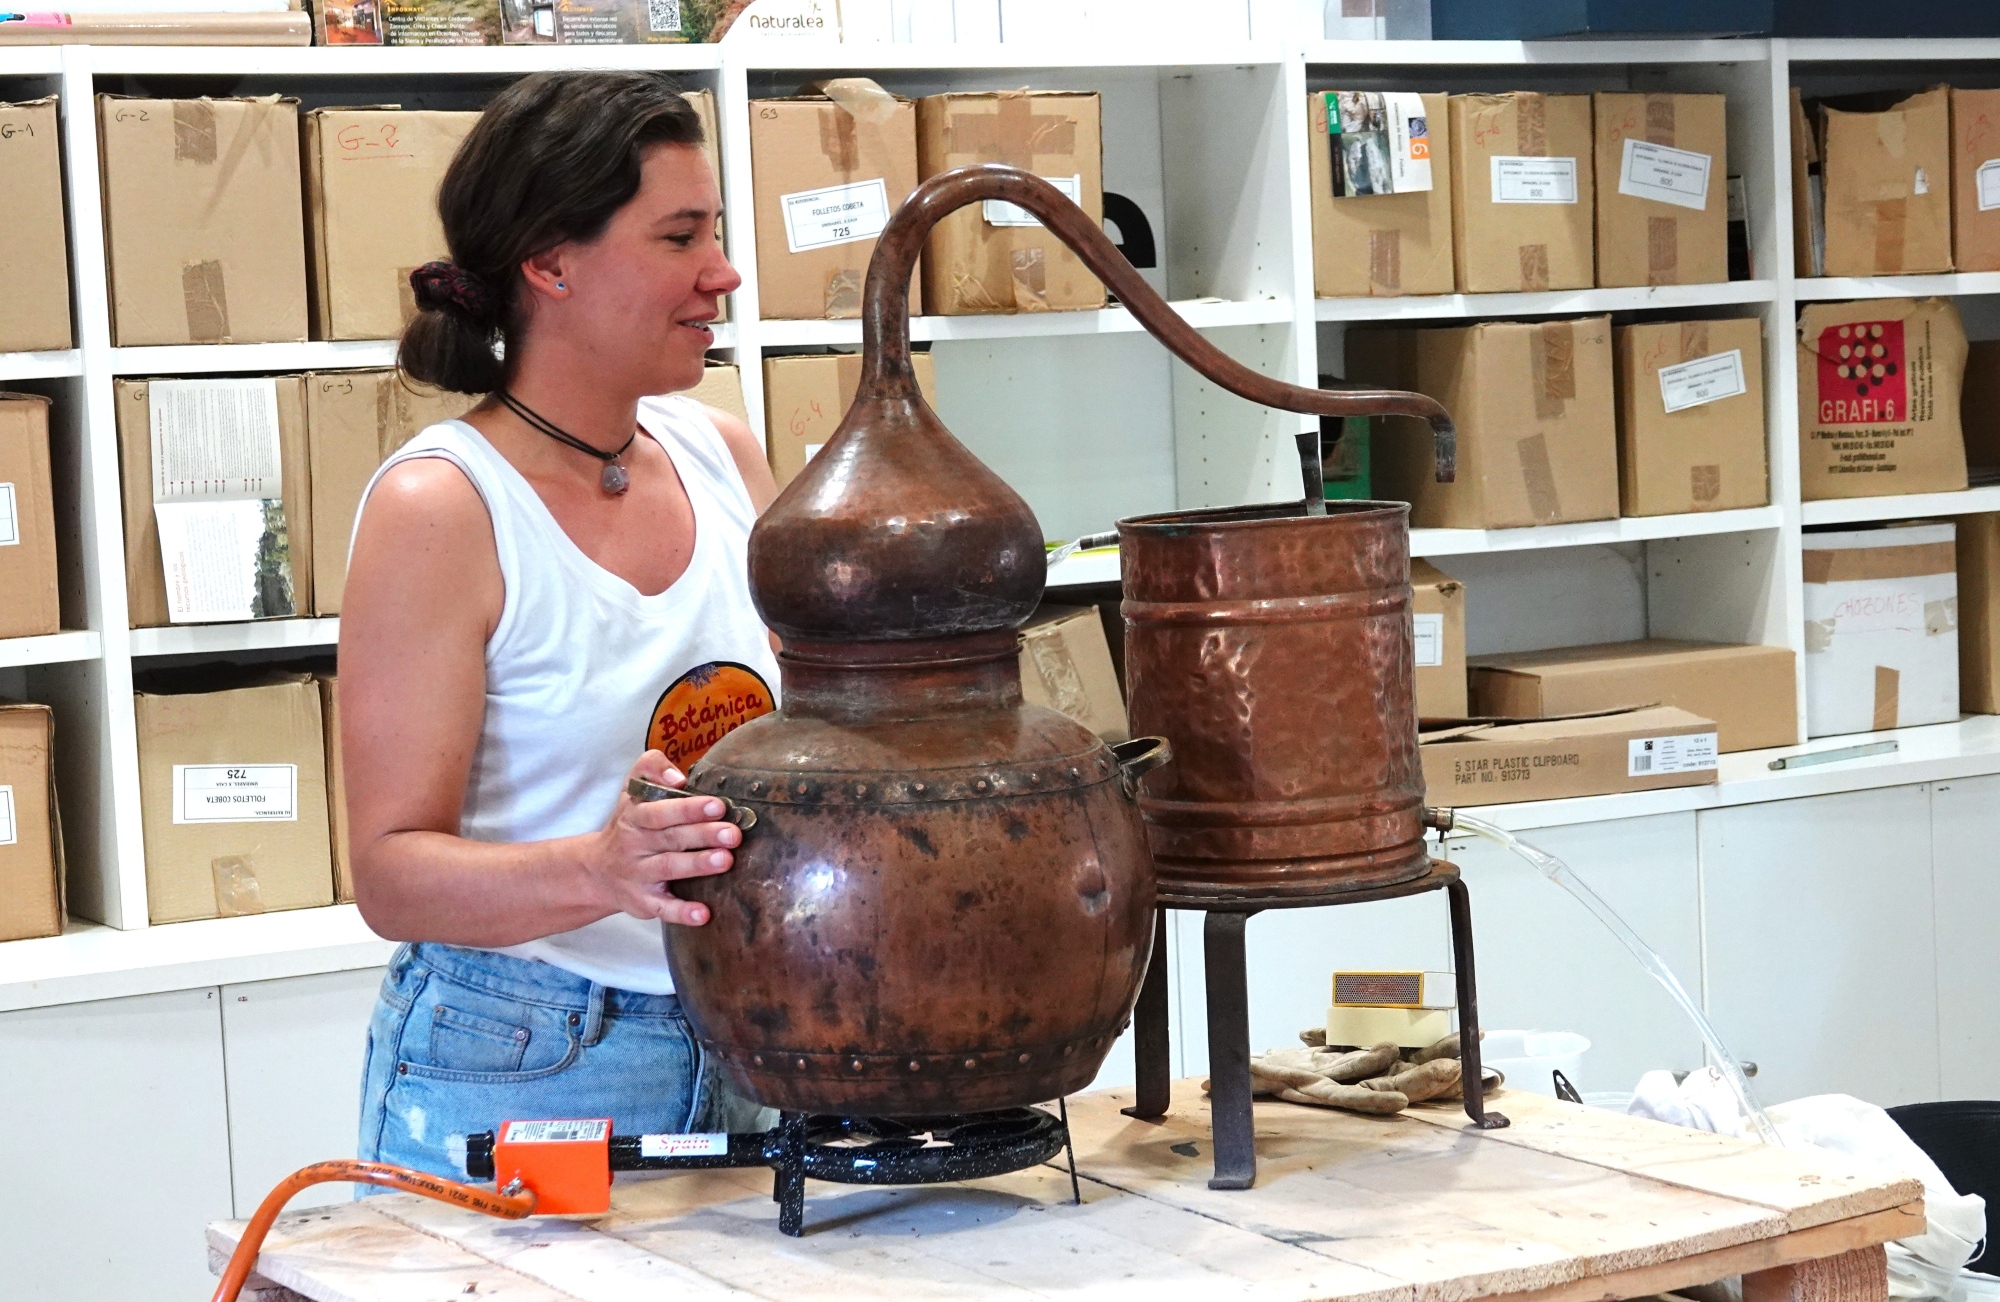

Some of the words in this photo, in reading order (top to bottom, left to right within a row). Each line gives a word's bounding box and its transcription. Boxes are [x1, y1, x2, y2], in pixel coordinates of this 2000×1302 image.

[812, 204, 841, 216] FOLLETOS
[842, 201, 864, 212] COBETA
[832, 226, 850, 238] 725
[659, 694, 762, 741] Botánica
[1455, 761, 1461, 772] 5
[1465, 760, 1488, 771] STAR
[1493, 756, 1529, 770] PLASTIC
[1533, 754, 1579, 767] CLIPBOARD
[227, 770, 246, 779] 725
[1455, 772, 1476, 784] PART
[1502, 769, 1530, 781] 913713
[659, 1136, 709, 1153] Spain
[449, 1189, 469, 1202] 2021
